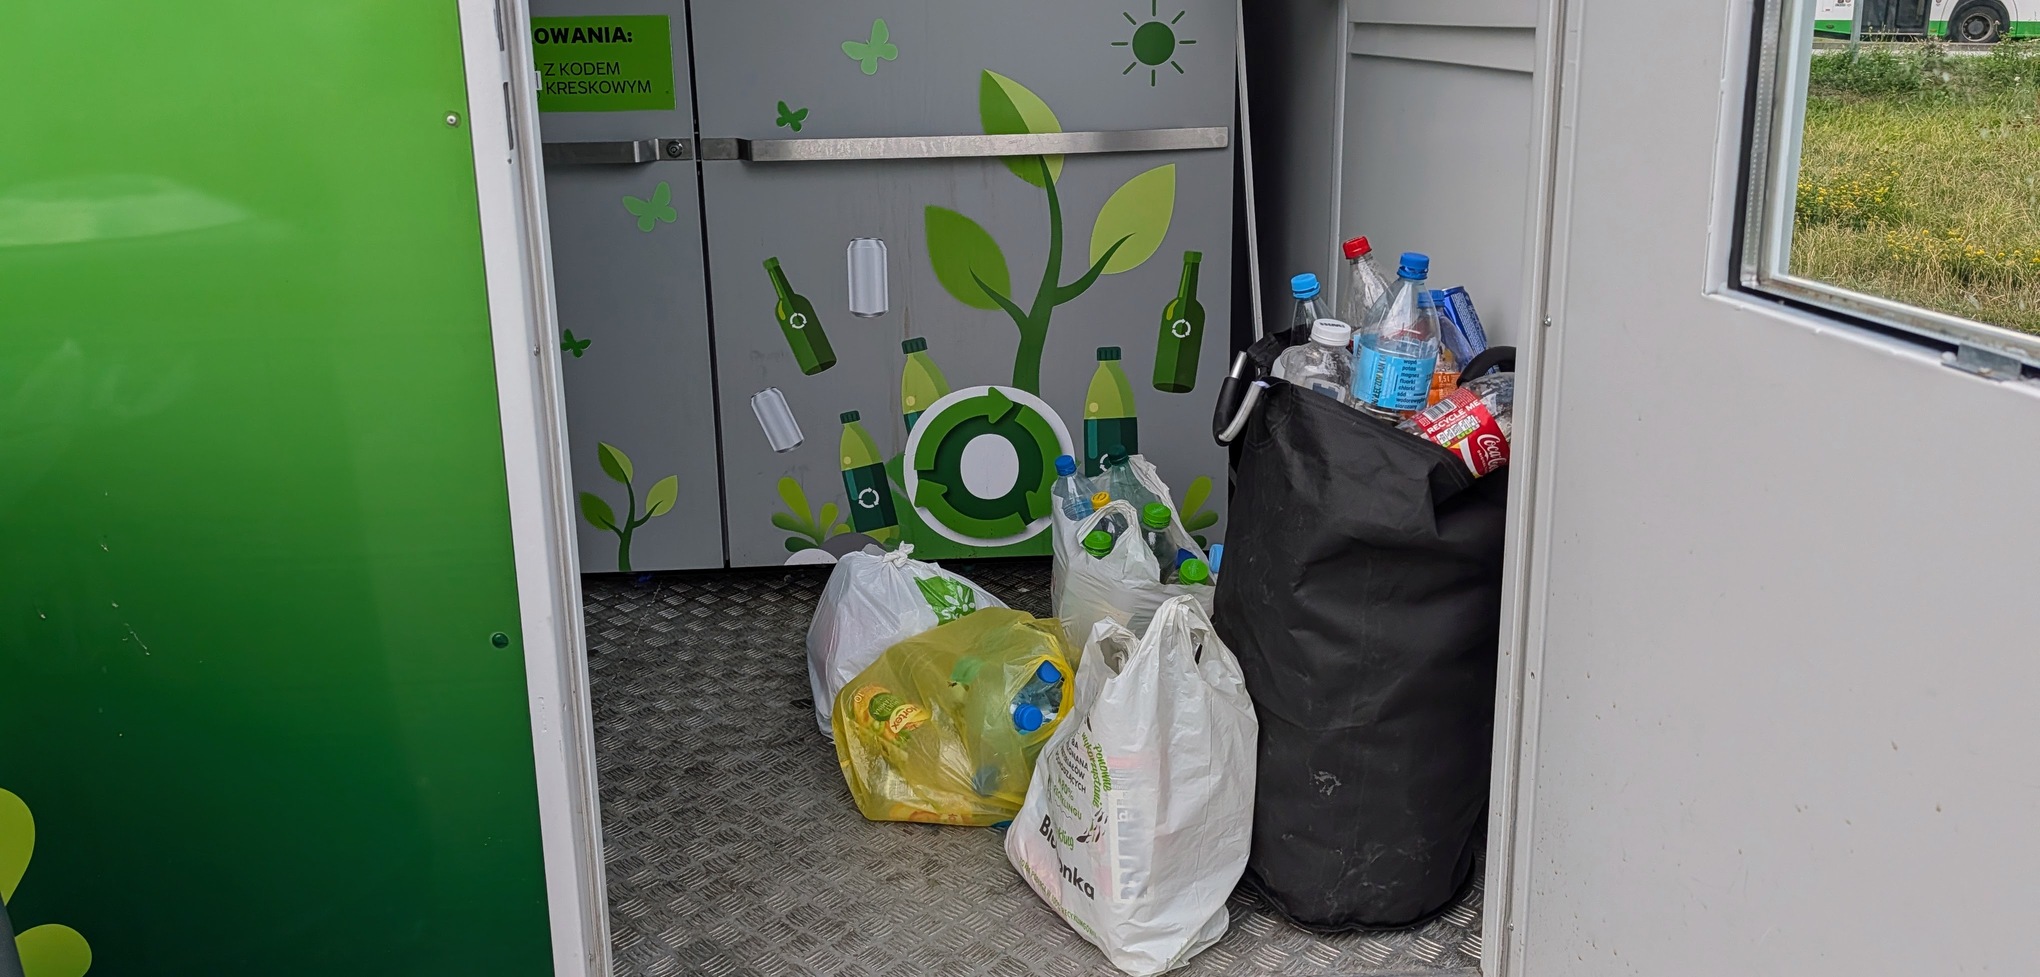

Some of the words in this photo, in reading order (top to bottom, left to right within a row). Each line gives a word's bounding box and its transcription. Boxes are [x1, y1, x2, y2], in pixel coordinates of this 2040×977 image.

[534, 26, 633, 44] OWANIA:
[544, 63, 556, 76] Z
[560, 62, 620, 76] KODEM
[546, 80, 652, 95] KRESKOWYM
[1427, 408, 1466, 434] RECYCLE
[1466, 399, 1481, 411] ME
[1082, 732, 1103, 808] wykorzystanie
[1093, 743, 1112, 792] Ponowne
